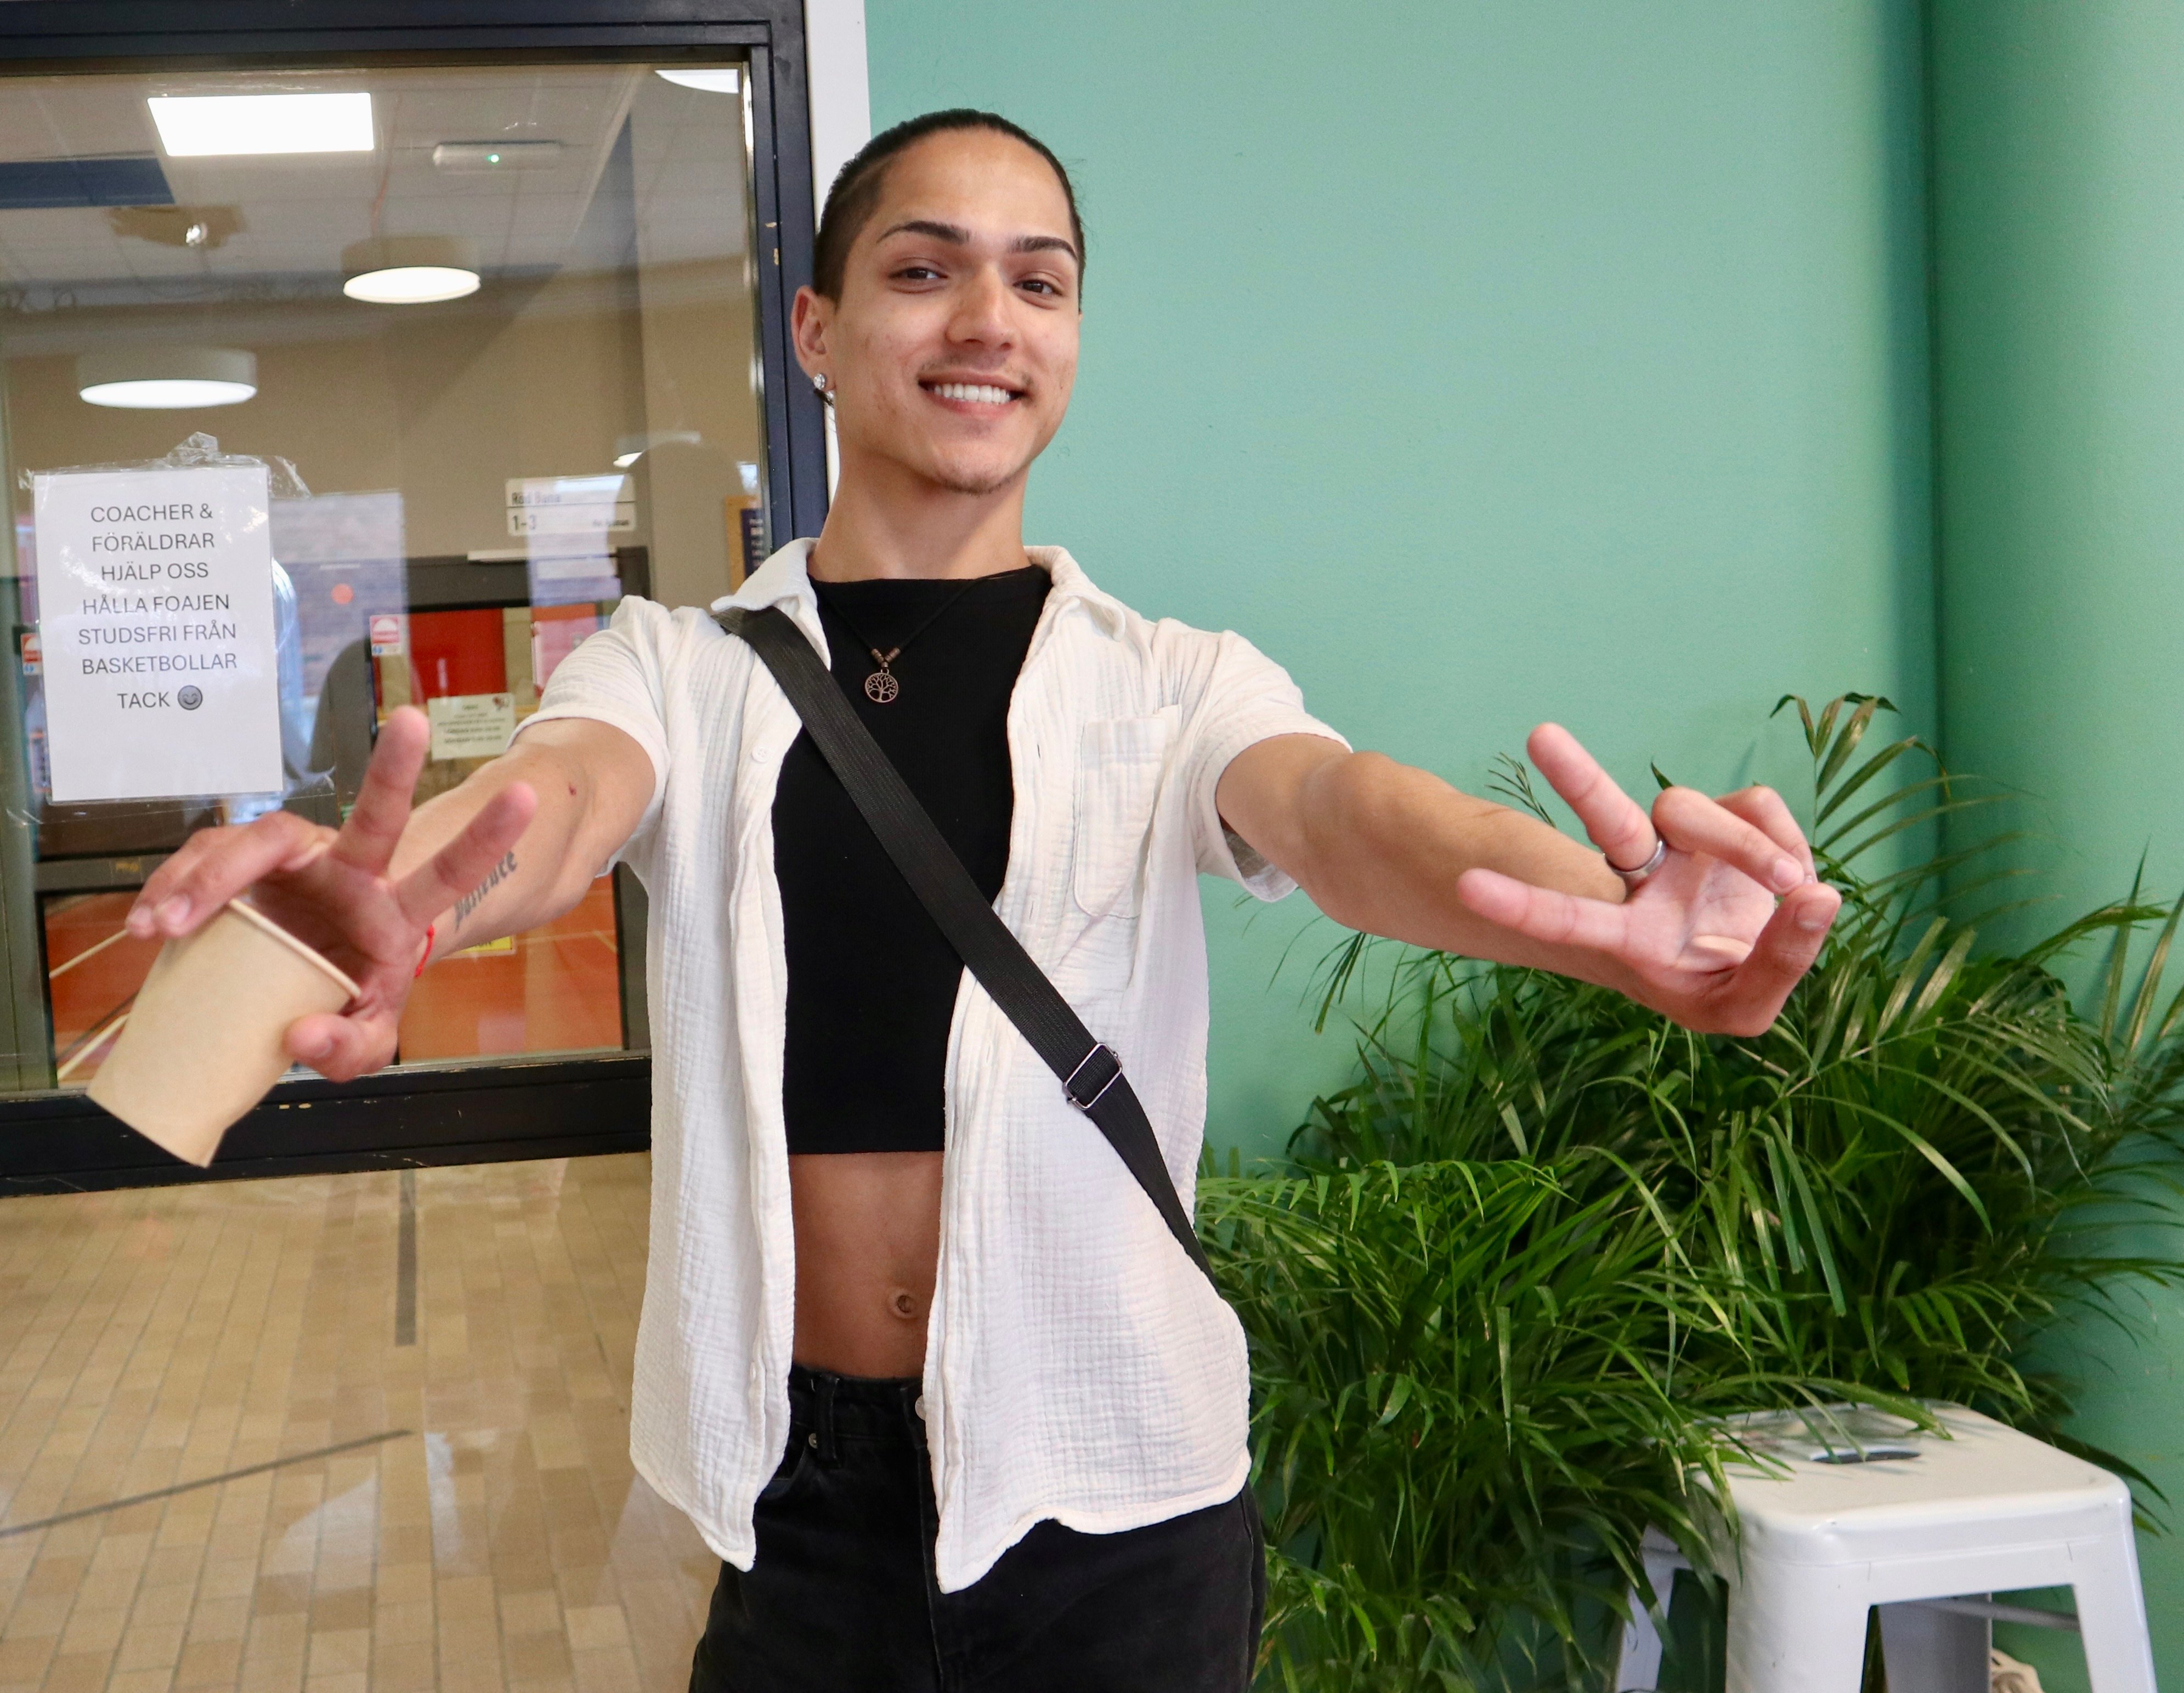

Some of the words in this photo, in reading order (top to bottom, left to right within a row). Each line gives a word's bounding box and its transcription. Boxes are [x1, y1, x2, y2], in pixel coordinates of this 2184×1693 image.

[91, 504, 194, 522] COACHER
[200, 503, 213, 519] &
[93, 531, 215, 552] FÖRÄLDRAR
[101, 561, 162, 581] HJÄLP
[167, 562, 209, 580] OSS
[83, 594, 148, 615] HÅLLA
[153, 594, 230, 612] FOAJEN
[79, 626, 177, 645] STUDSFRI
[184, 619, 236, 641] FRÅN
[82, 653, 237, 675] BASKETBOLLAR
[117, 692, 171, 709] TACK
